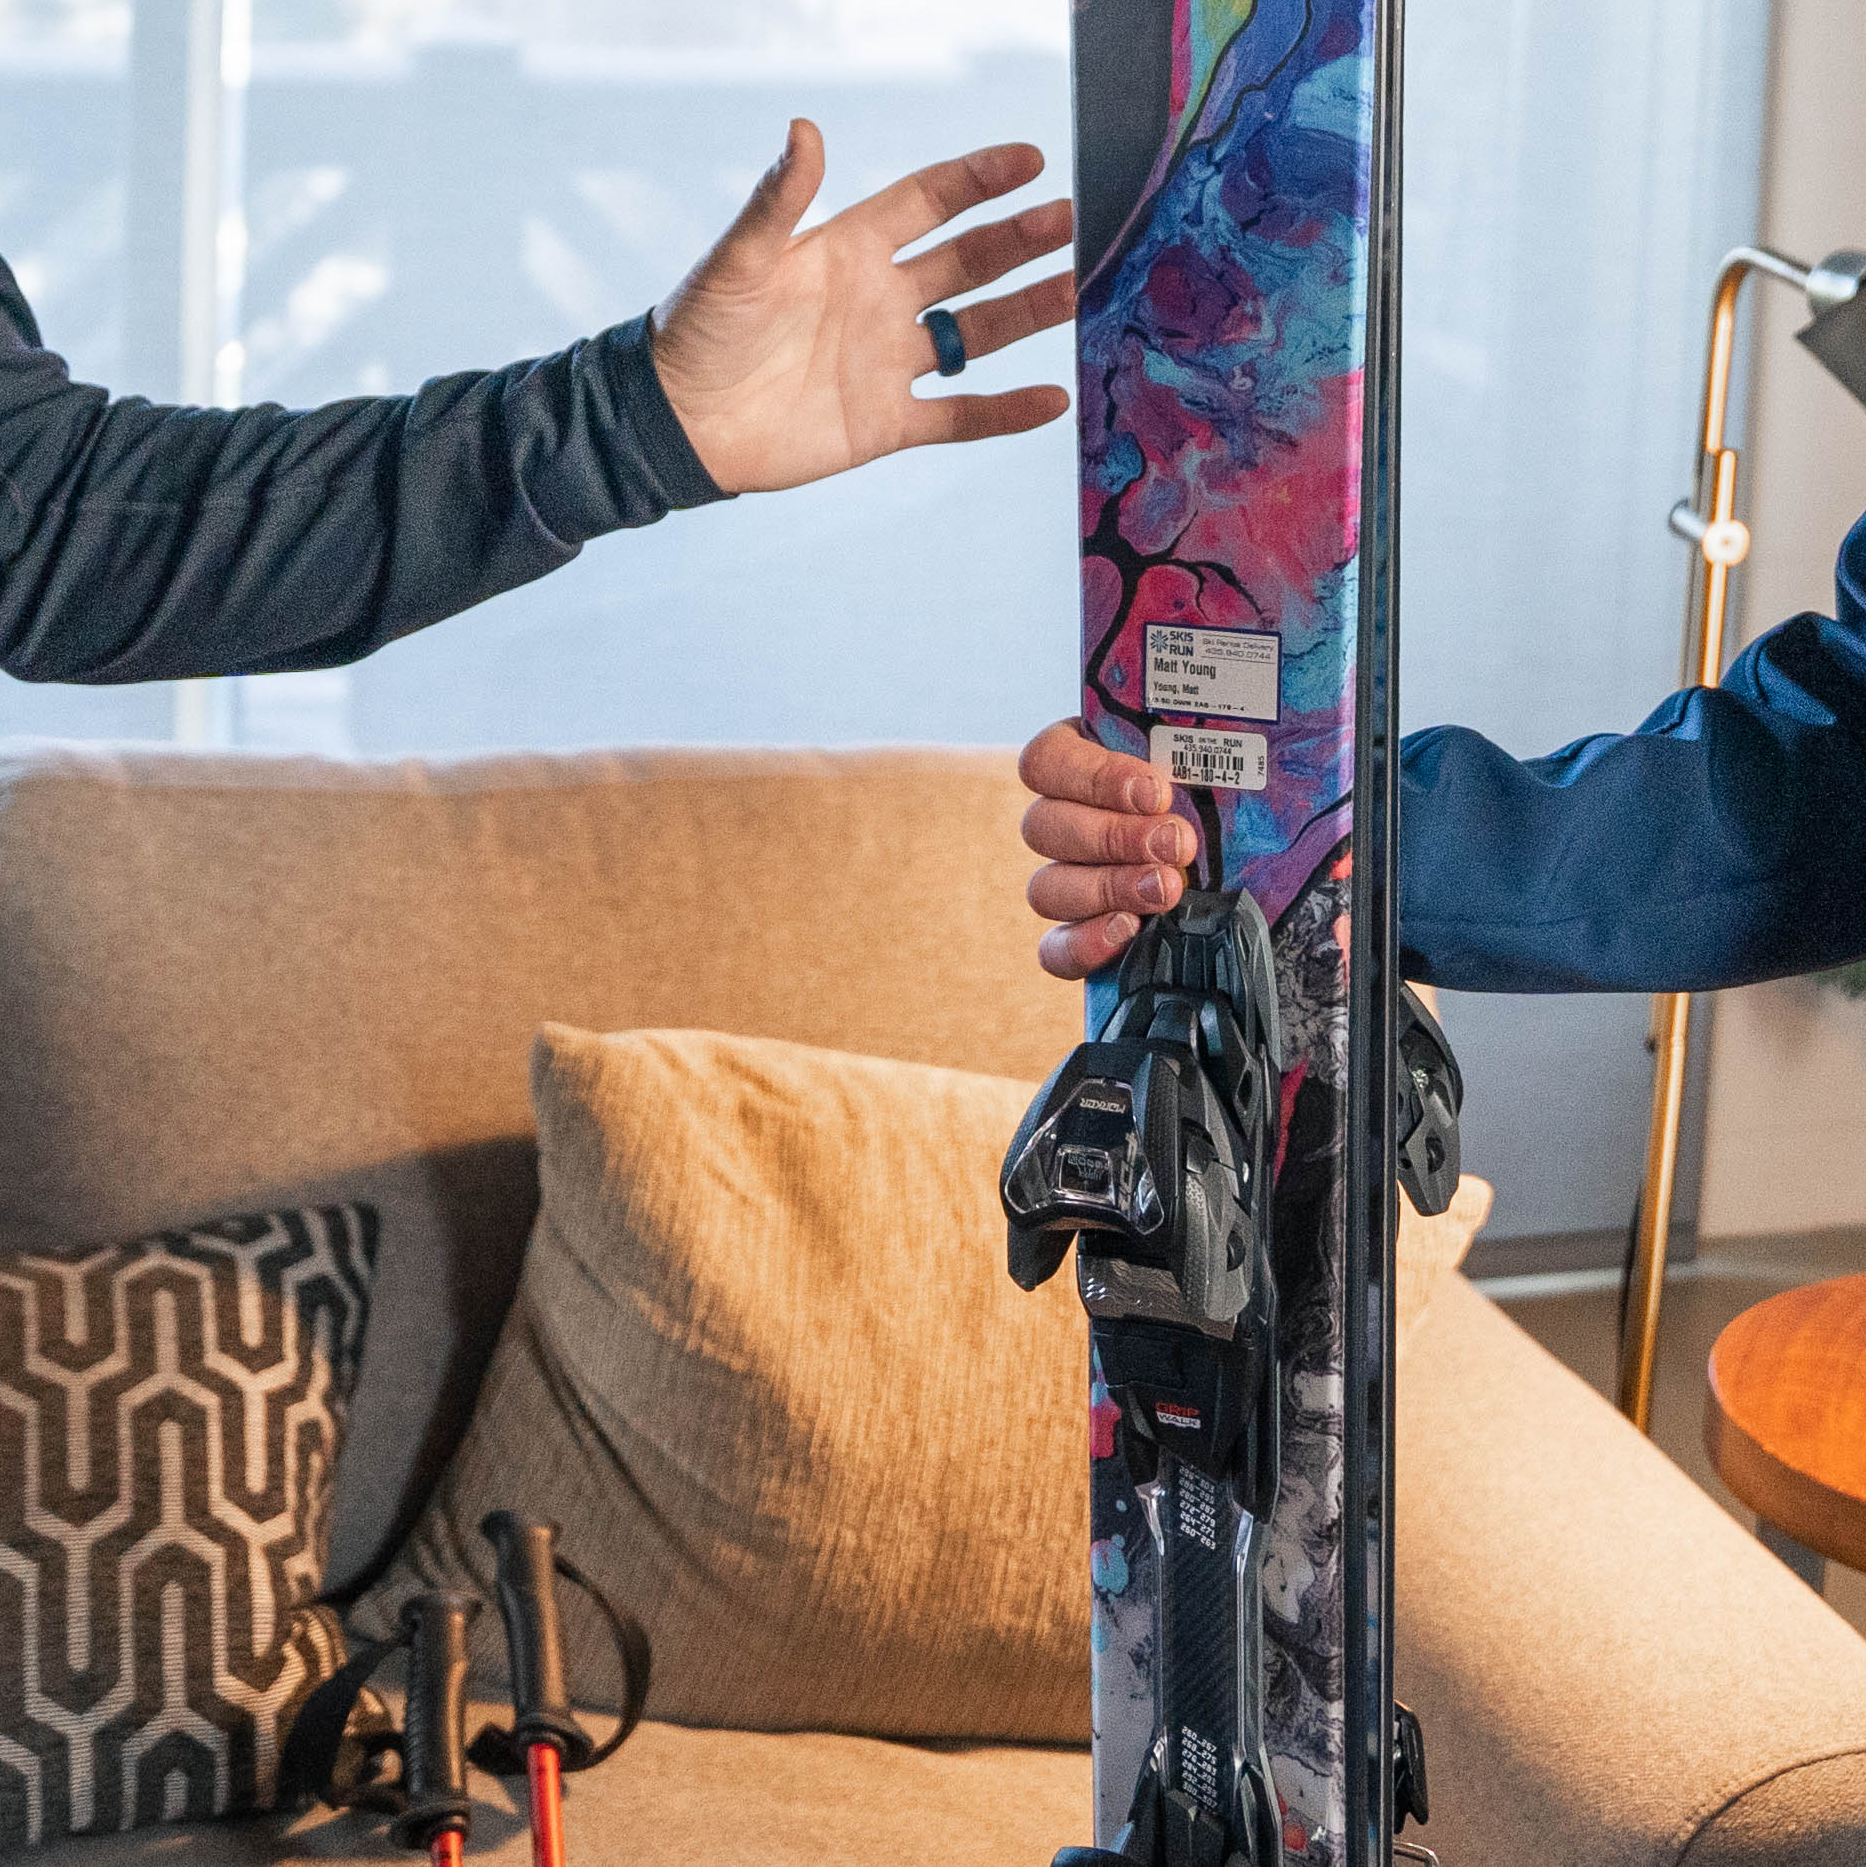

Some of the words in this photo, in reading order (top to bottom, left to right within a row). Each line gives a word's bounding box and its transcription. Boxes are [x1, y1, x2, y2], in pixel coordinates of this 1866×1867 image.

[1169, 630, 1194, 642] SKIS
[1169, 644, 1194, 657] RUN
[1154, 657, 1178, 673] Matt
[1182, 659, 1217, 680] Young
[1173, 734, 1194, 744] SKIS
[1223, 737, 1243, 749] RUN
[1080, 1098, 1126, 1114] MARKER
[1156, 1402, 1199, 1417] GRIP
[1157, 1412, 1199, 1427] WALK
